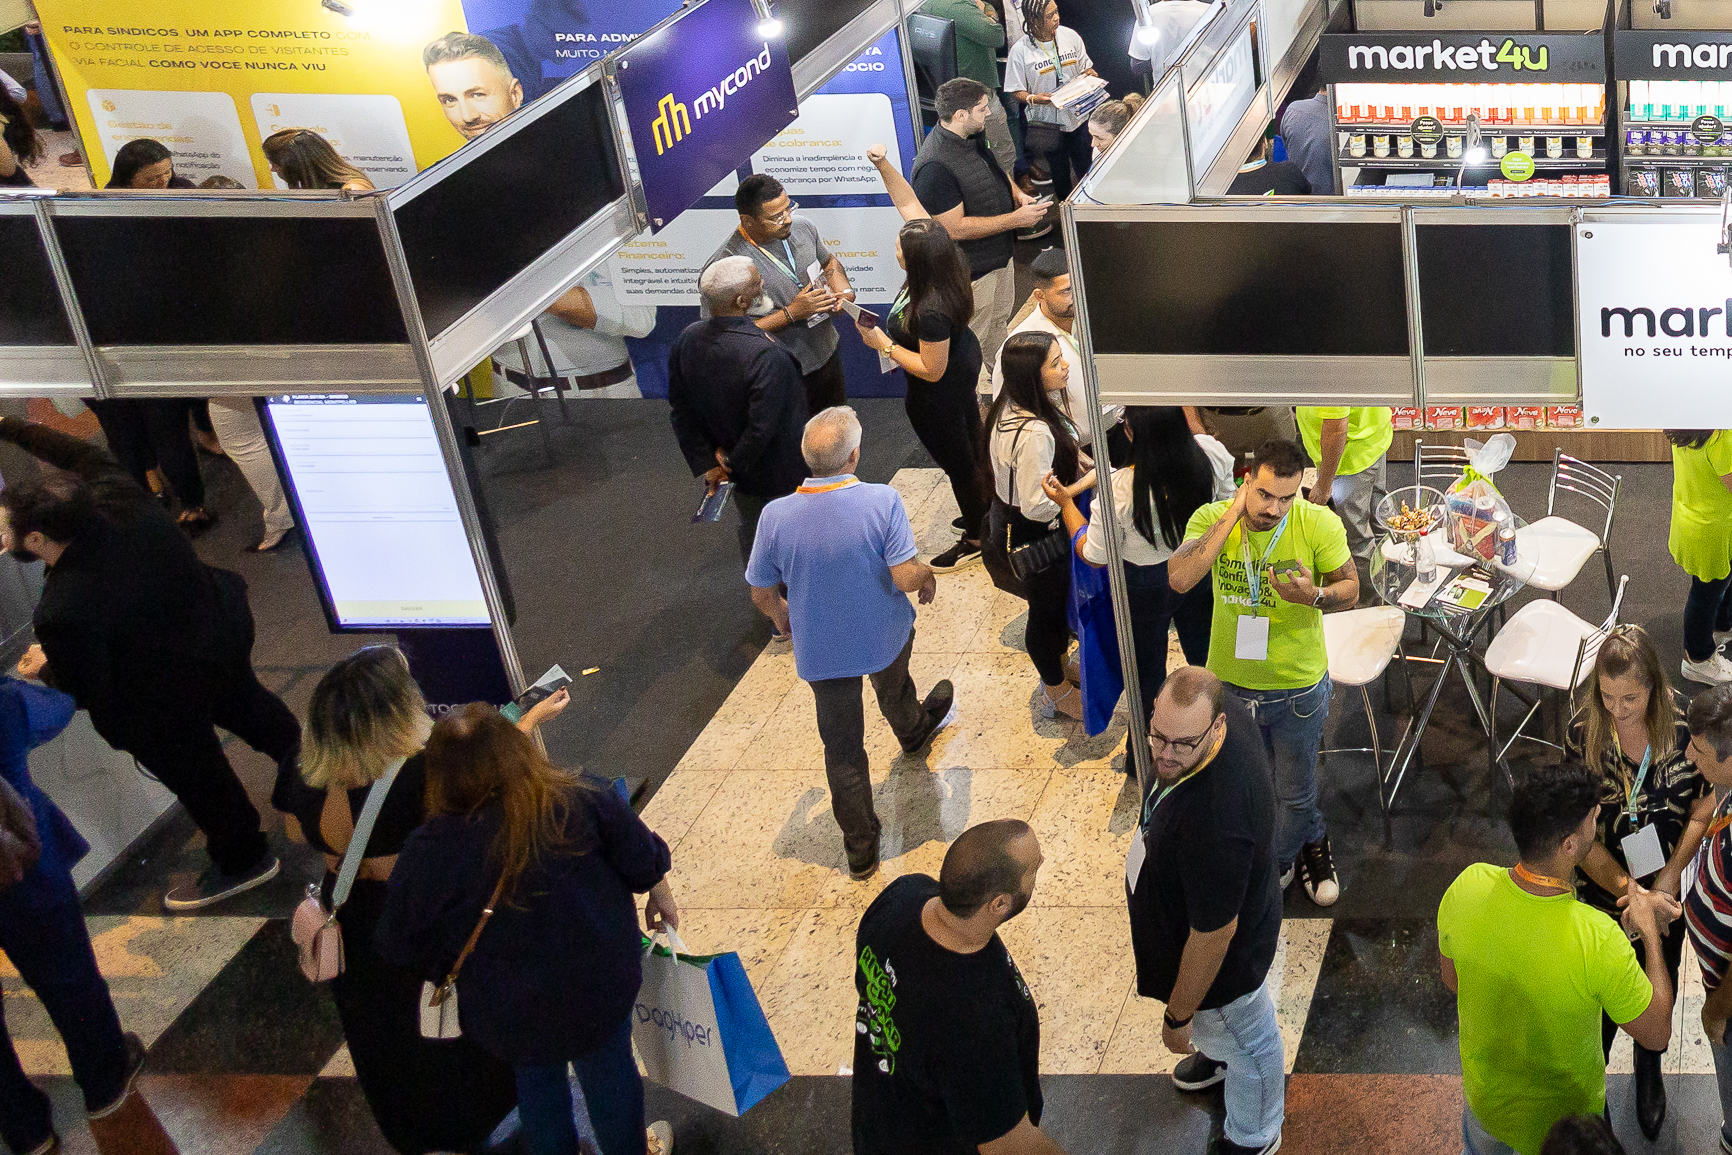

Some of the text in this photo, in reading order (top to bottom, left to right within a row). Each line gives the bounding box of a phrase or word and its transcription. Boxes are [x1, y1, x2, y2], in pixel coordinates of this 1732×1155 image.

[63, 26, 103, 35] PARA
[185, 29, 209, 37] UM
[213, 29, 244, 38] APP
[247, 30, 331, 40] COMPLETO
[555, 33, 597, 43] PARA
[84, 42, 349, 56] CONTROLE DE ACESSO DE VISITANTES
[555, 49, 600, 59] MUITO
[1348, 39, 1548, 72] market4u
[99, 58, 145, 67] FACIAL
[149, 59, 197, 69] COMO
[245, 61, 298, 71] NUNCA
[301, 62, 327, 72] VIU
[694, 42, 772, 121] mycond
[778, 139, 842, 150] cobrança:
[763, 155, 795, 163] Diminua
[765, 166, 807, 174] economize
[810, 167, 837, 175] tempo
[818, 177, 832, 185] por
[618, 251, 686, 260] Financeiro:
[834, 249, 878, 258] marca:
[621, 267, 652, 276] Simples,
[1624, 348, 1645, 357] no
[1653, 348, 1683, 357] seu
[1432, 407, 1457, 416] Neve
[1514, 407, 1538, 416] Neve
[1554, 406, 1578, 415] Neve
